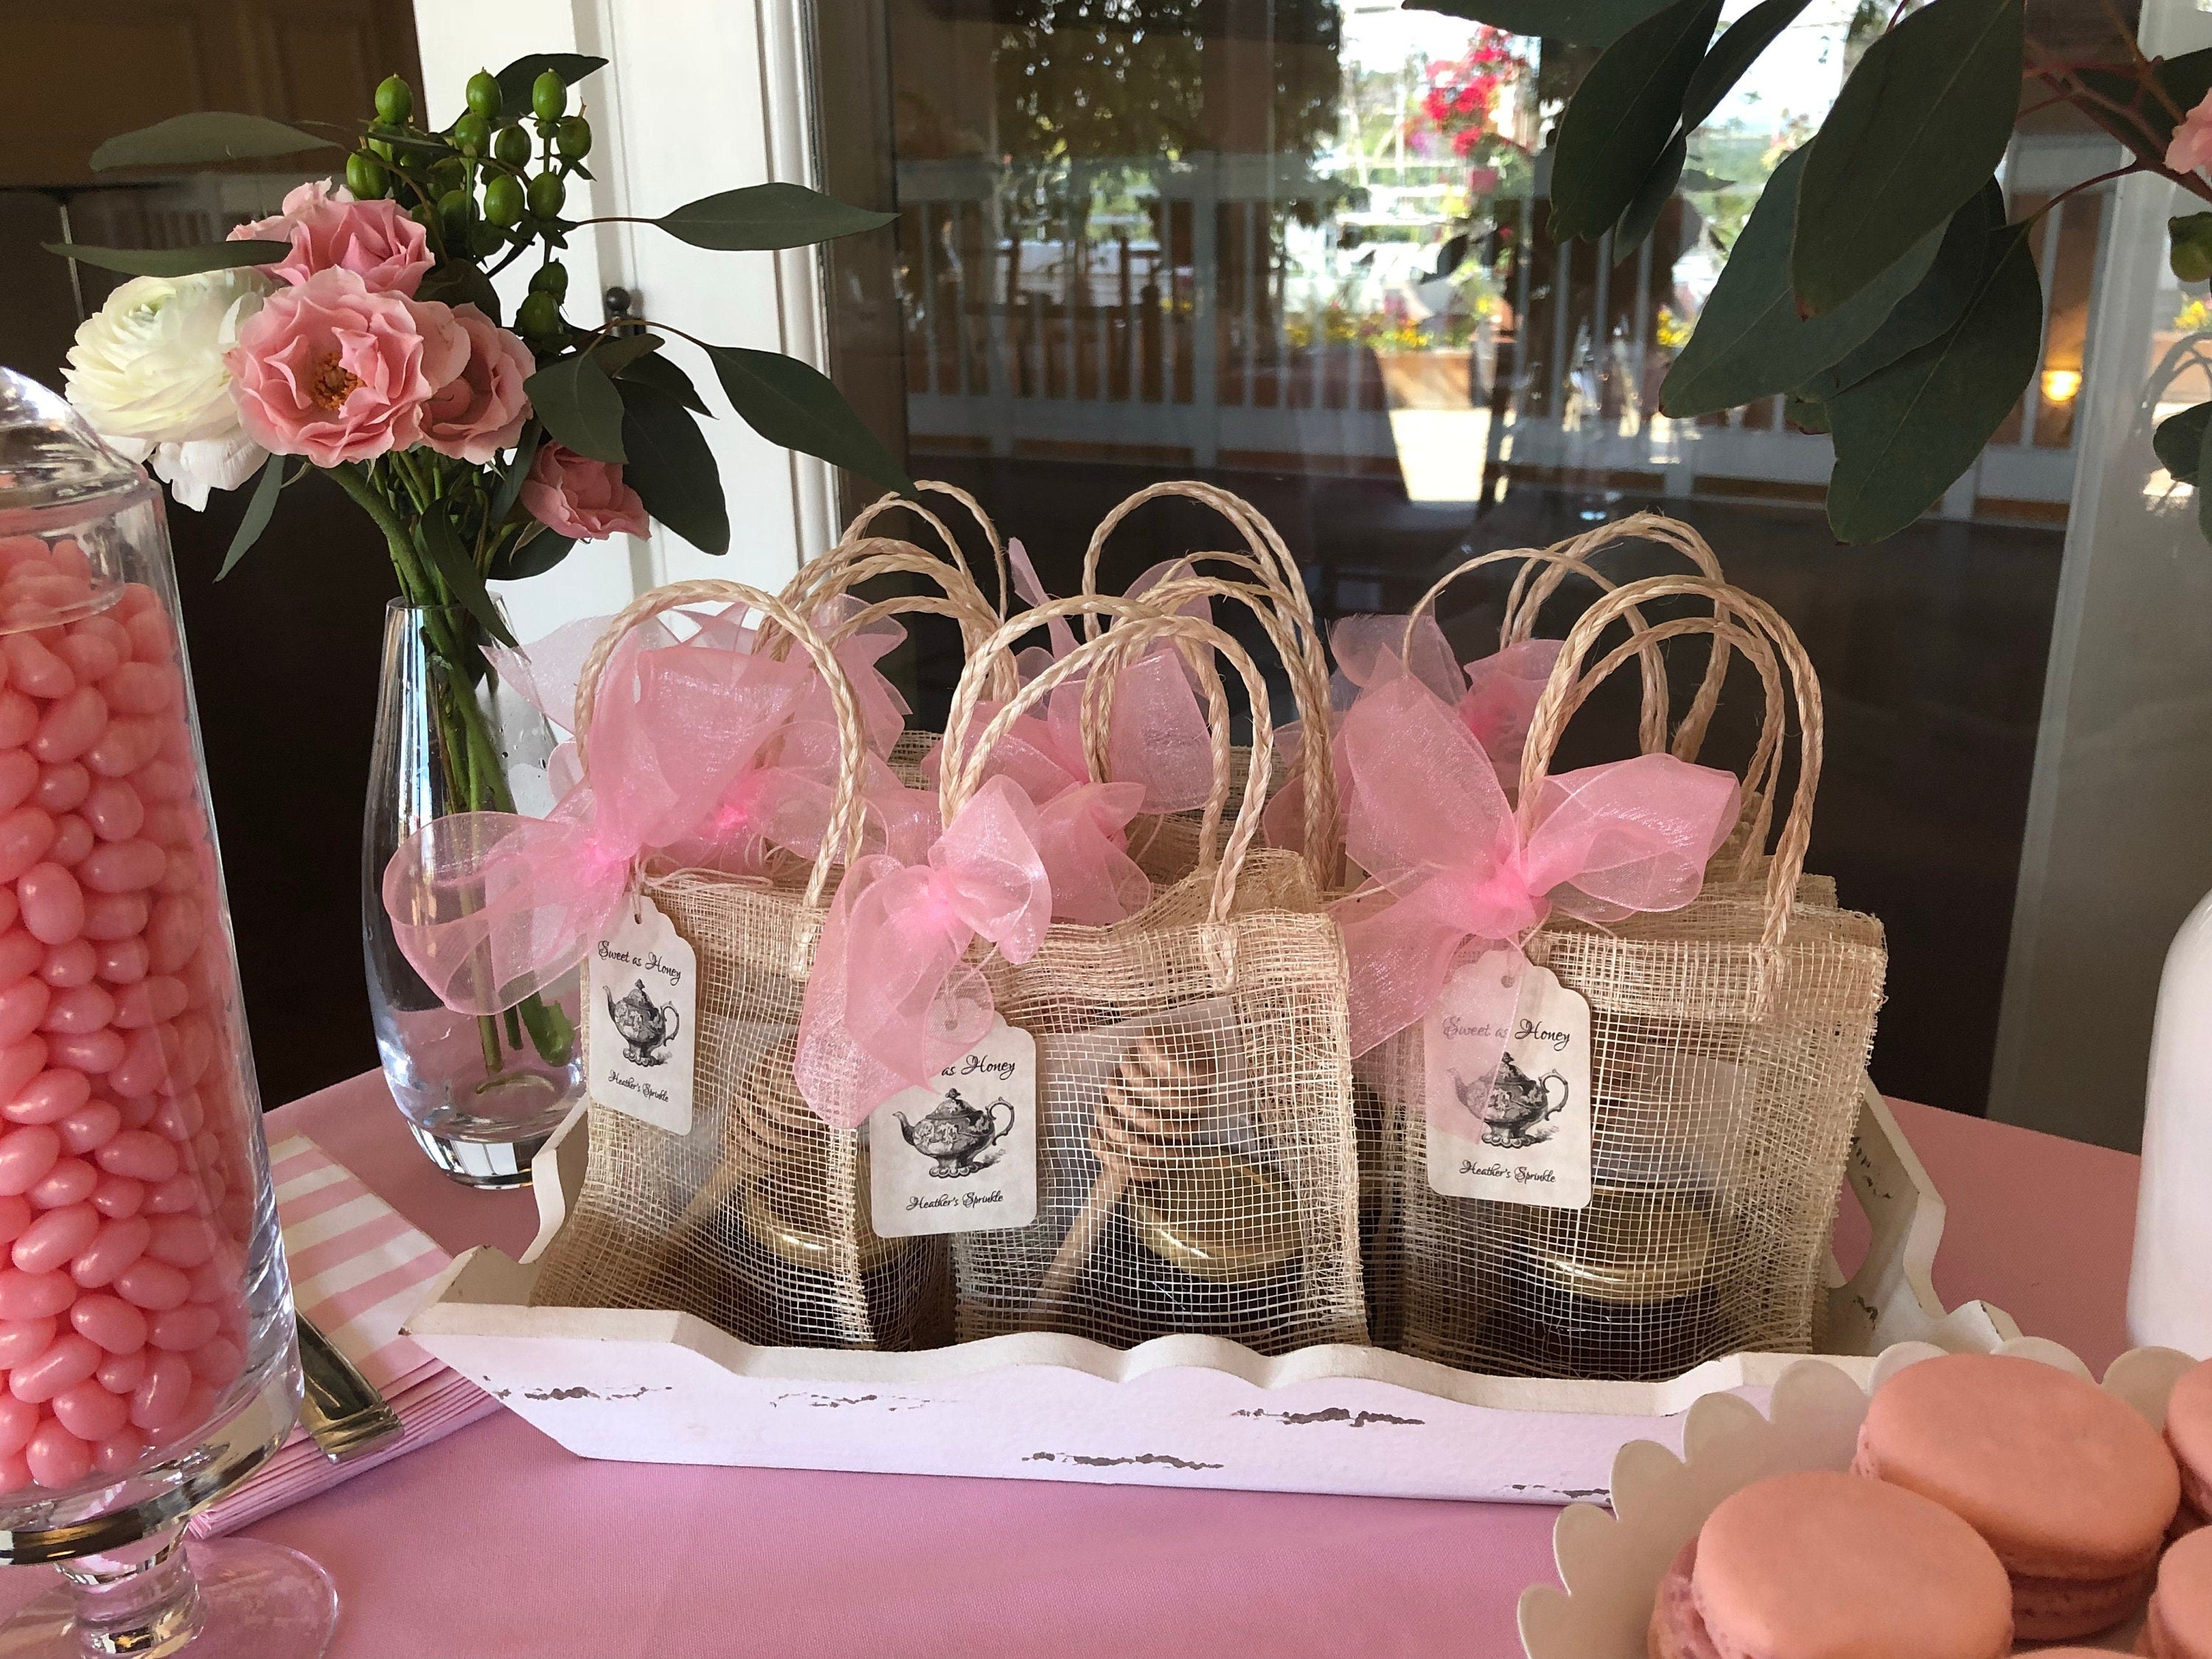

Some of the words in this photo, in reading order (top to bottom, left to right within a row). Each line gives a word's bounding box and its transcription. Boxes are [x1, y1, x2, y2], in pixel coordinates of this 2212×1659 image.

[598, 940, 629, 963] Sweet
[632, 957, 641, 967] as
[645, 952, 681, 985] Honey
[1443, 1016, 1491, 1040] Sweet
[1514, 1018, 1570, 1051] Honey
[942, 1065, 956, 1076] as
[961, 1054, 1015, 1080] Honey
[608, 1069, 640, 1092] Heather's
[642, 1083, 669, 1102] Sprinkle
[1459, 1159, 1511, 1178] Heather's
[1514, 1166, 1556, 1184] Sprinkle
[906, 1194, 959, 1211] Heather's
[962, 1191, 1004, 1208] Sprinkle
